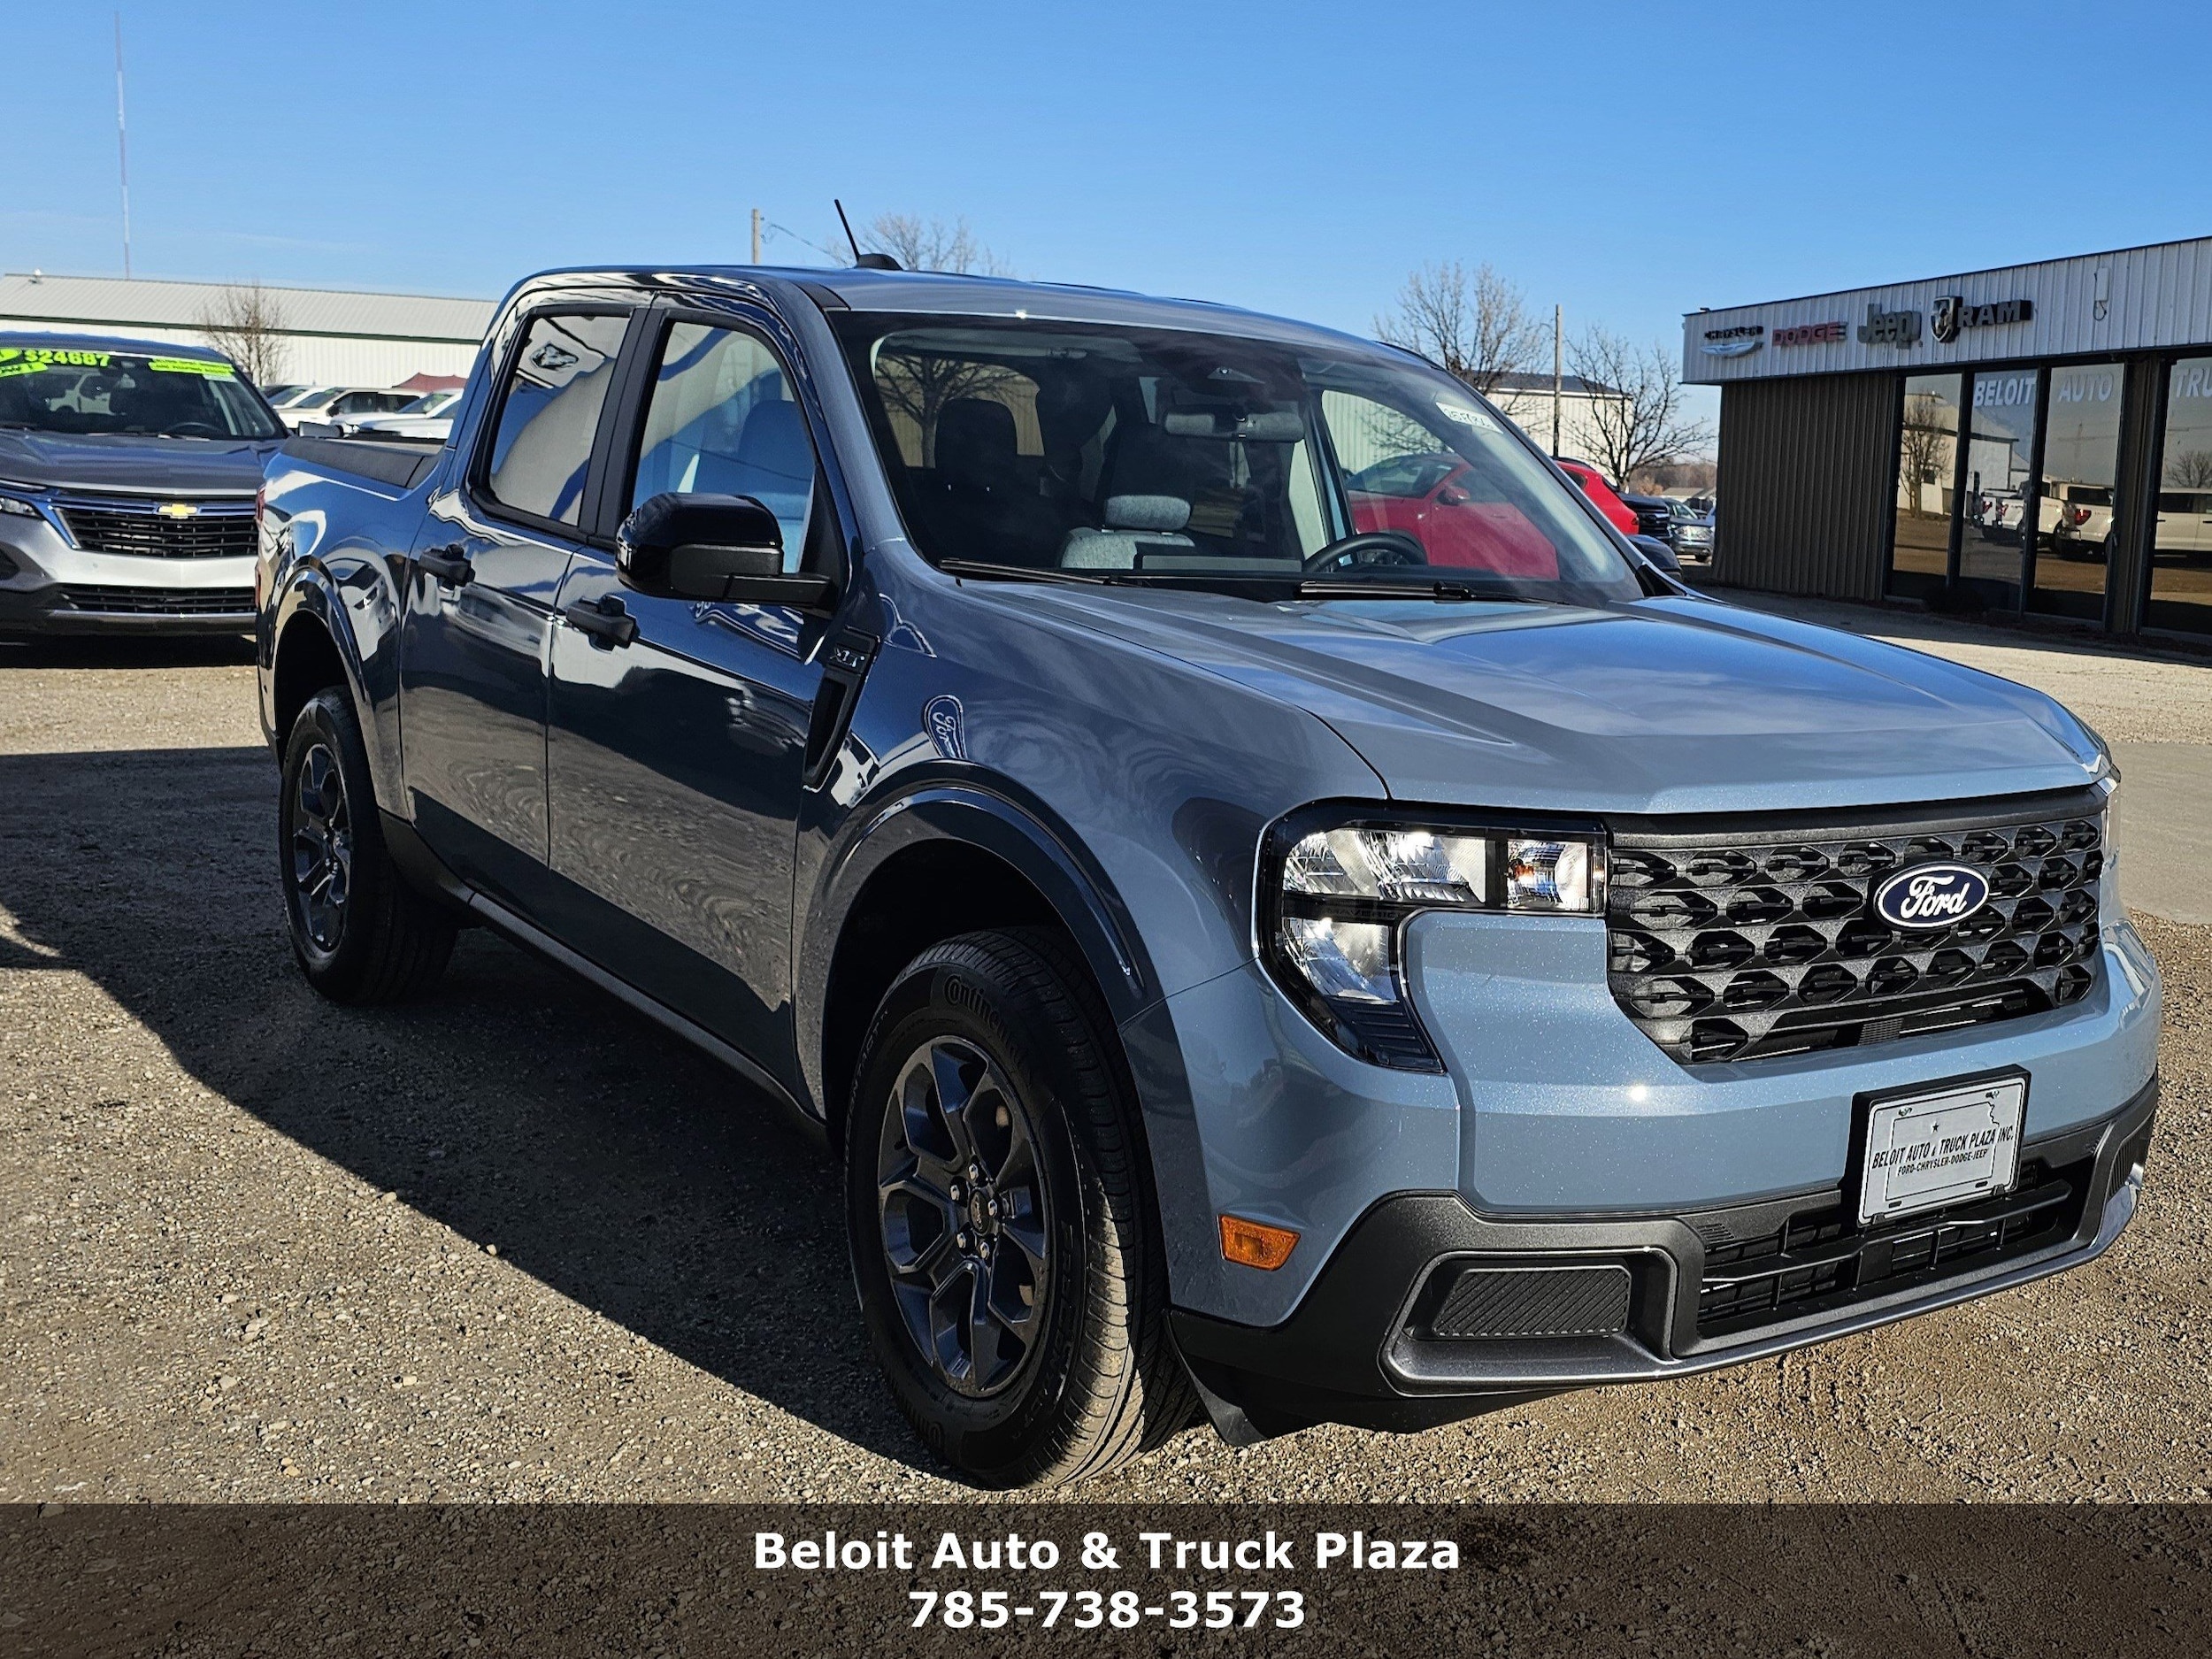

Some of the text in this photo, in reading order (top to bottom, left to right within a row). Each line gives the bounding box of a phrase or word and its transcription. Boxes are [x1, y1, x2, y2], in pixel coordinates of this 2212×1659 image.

[1857, 303, 1913, 349] Jeep
[1957, 301, 2024, 327] RAM
[1771, 322, 1843, 347] DODGE
[24, 349, 111, 367] $24687
[1974, 378, 2036, 407] BELOIT
[2057, 373, 2114, 403] AUTO
[1901, 875, 1970, 919] Ford
[1871, 1147, 1905, 1169] BELOIT
[1906, 1141, 1931, 1163] AUTO
[1939, 1134, 1968, 1156] TRUCK
[1969, 1128, 1996, 1149] PLAZA
[1998, 1125, 2014, 1142] INC.
[1897, 1148, 1988, 1177] FORD-CHRYSLER-DODGE-JEEP
